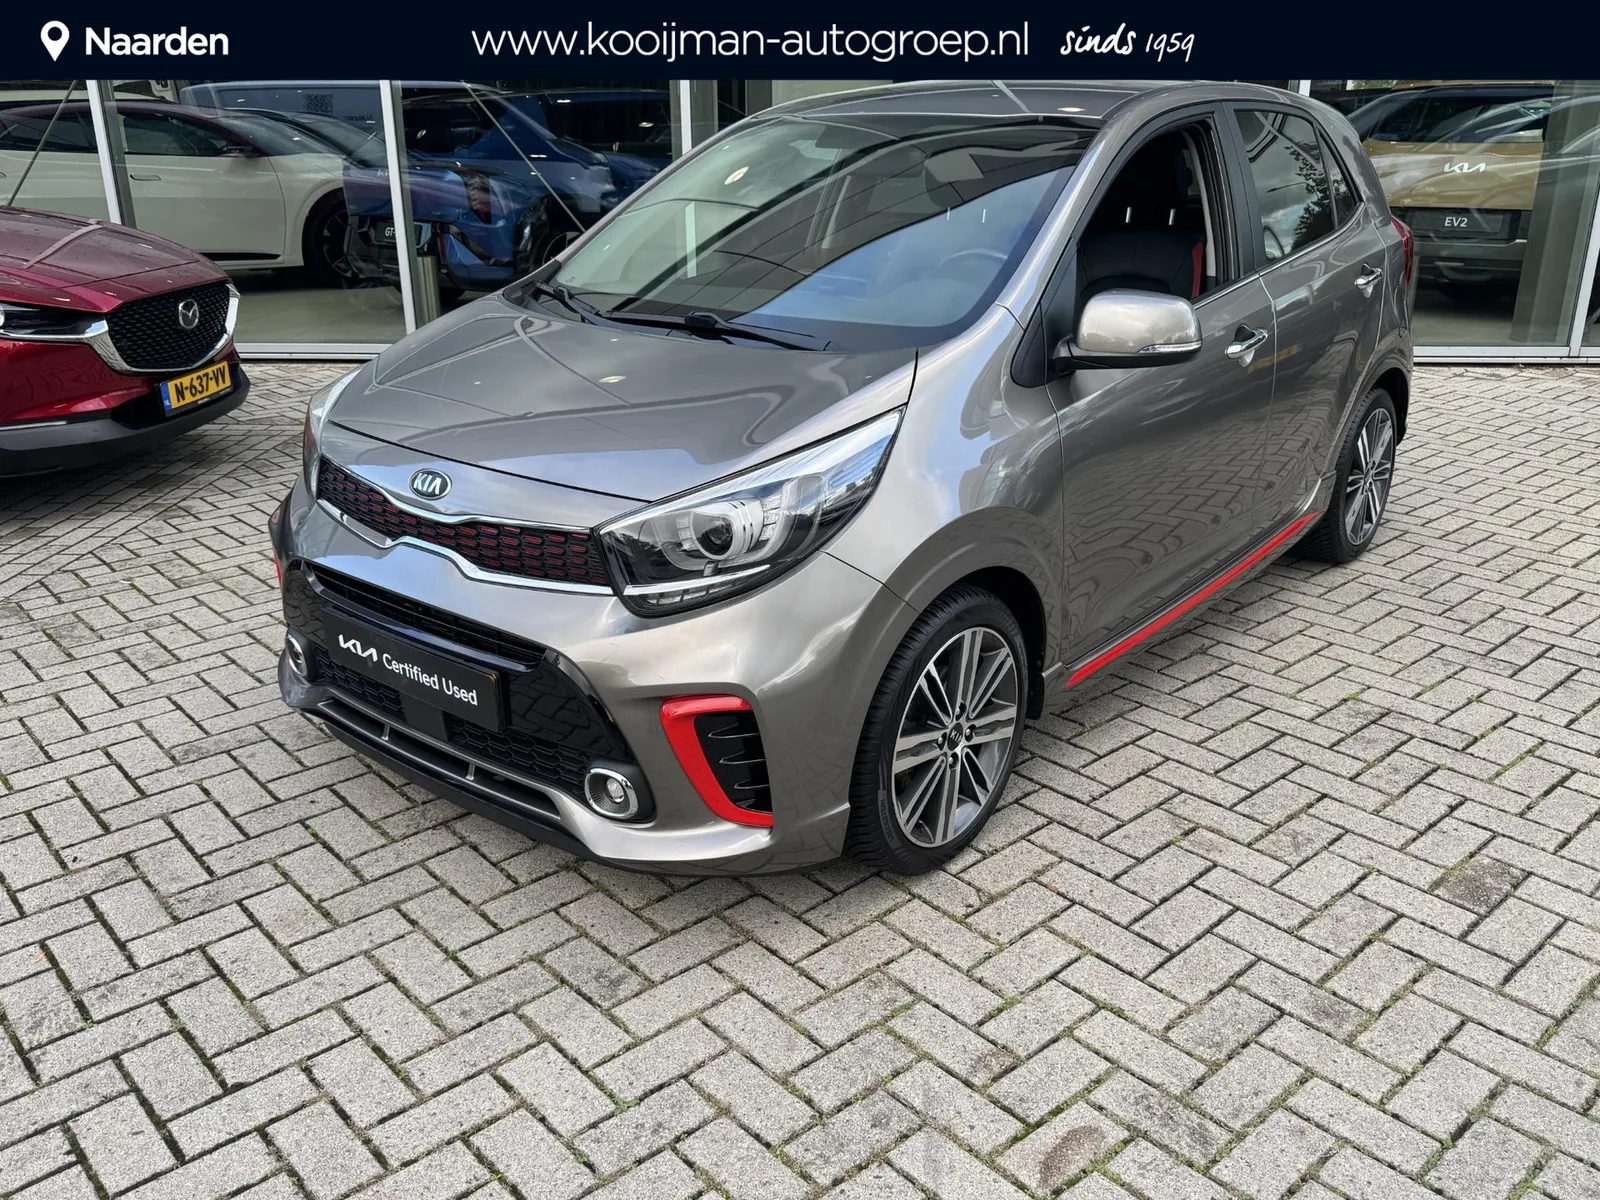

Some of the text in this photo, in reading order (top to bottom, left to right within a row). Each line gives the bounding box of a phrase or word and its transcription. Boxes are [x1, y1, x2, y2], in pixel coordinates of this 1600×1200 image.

[1443, 162, 1486, 173] KIA
[1444, 216, 1468, 228] EV2
[174, 365, 226, 403] N-637-VV
[413, 472, 442, 495] KIA
[382, 653, 440, 691] Certified
[441, 677, 479, 706] Used
[950, 729, 962, 743] KIA
